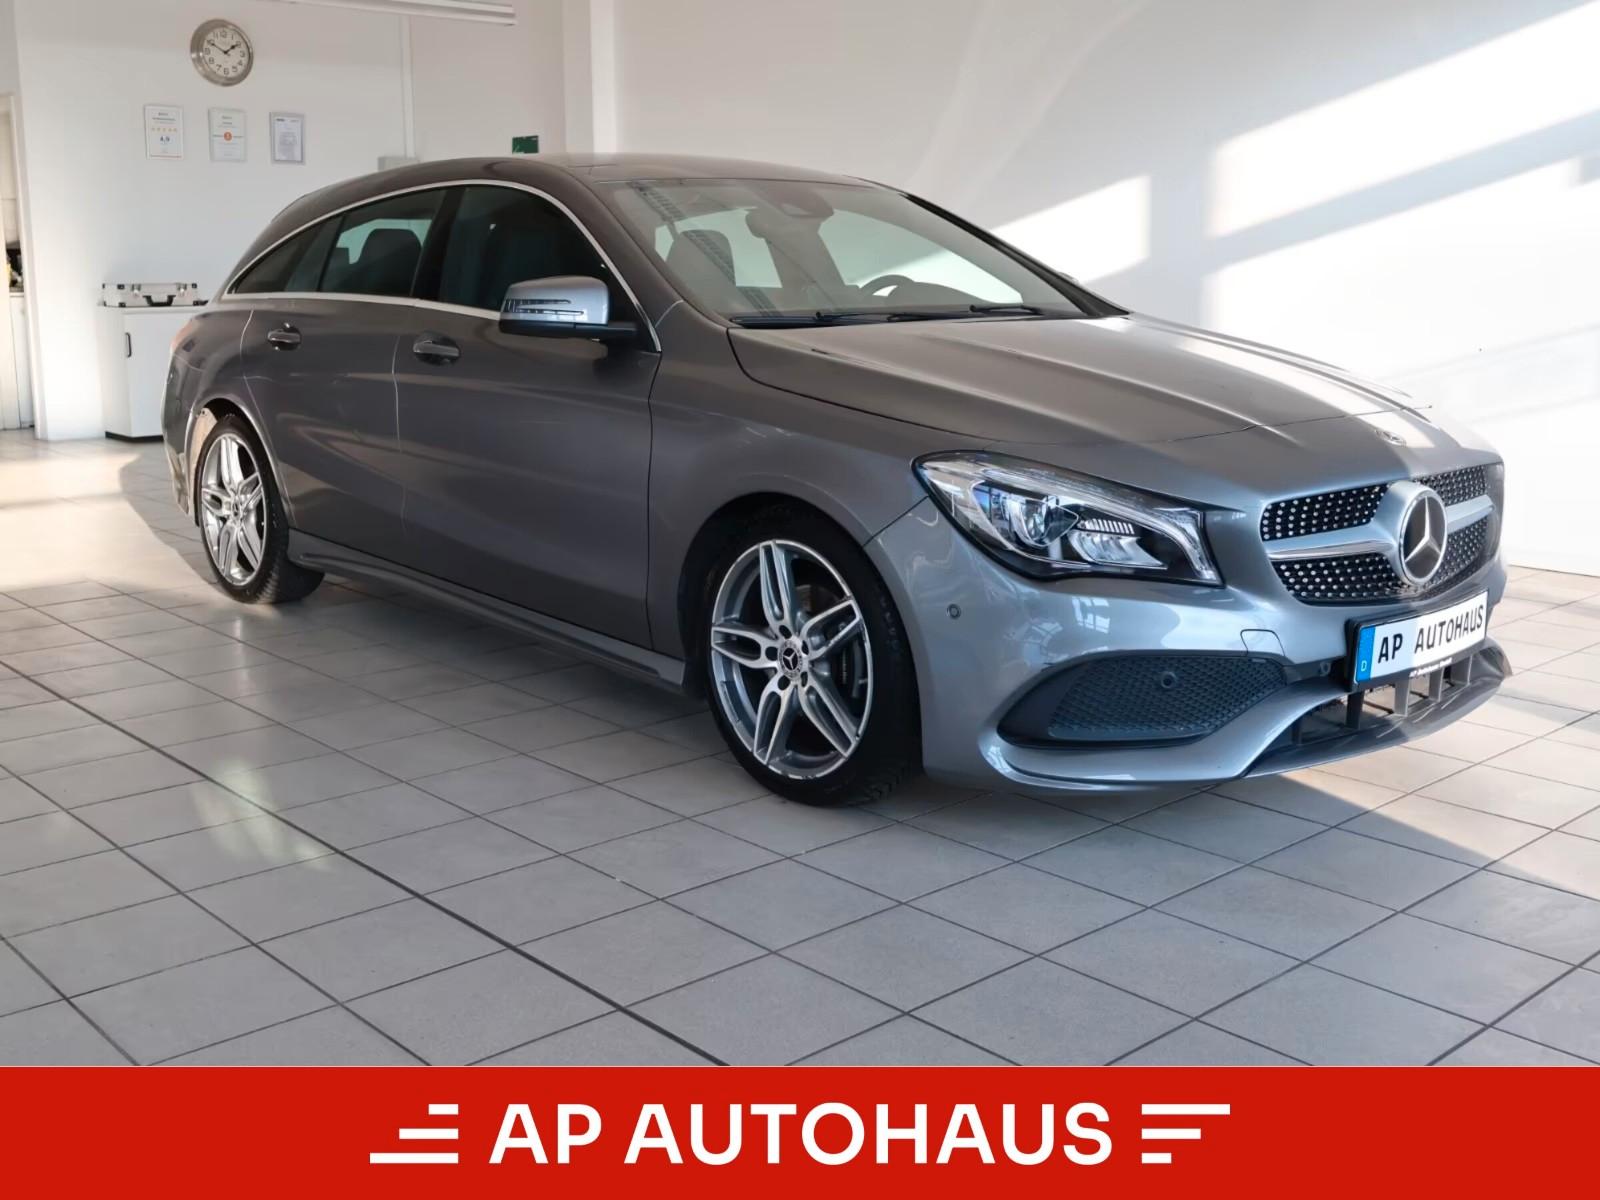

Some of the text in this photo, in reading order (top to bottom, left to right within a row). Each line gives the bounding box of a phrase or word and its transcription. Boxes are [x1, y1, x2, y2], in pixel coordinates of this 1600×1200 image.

[1361, 604, 1484, 672] D AP AUTOHAUS
